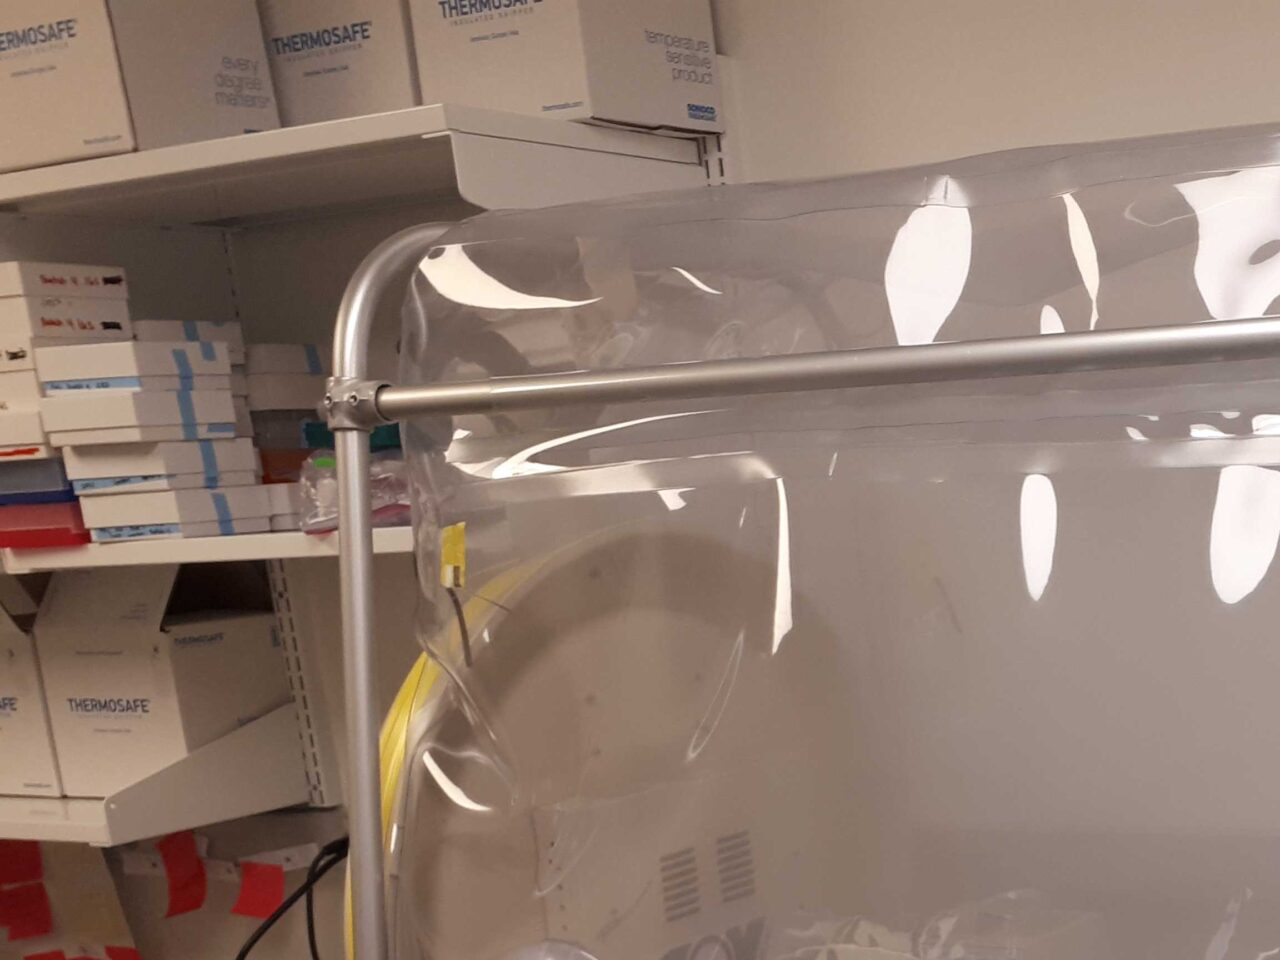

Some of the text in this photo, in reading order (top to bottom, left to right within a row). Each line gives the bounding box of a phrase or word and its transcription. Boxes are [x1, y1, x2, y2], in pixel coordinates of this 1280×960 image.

[438, 0, 542, 18] THERMO
[0, 18, 77, 51] ERMOSAFE
[272, 21, 370, 55] THERMOSAFE
[645, 28, 710, 53] temperature
[222, 56, 259, 75] every
[672, 66, 713, 85] product
[67, 698, 150, 713] THERMOSAFE
